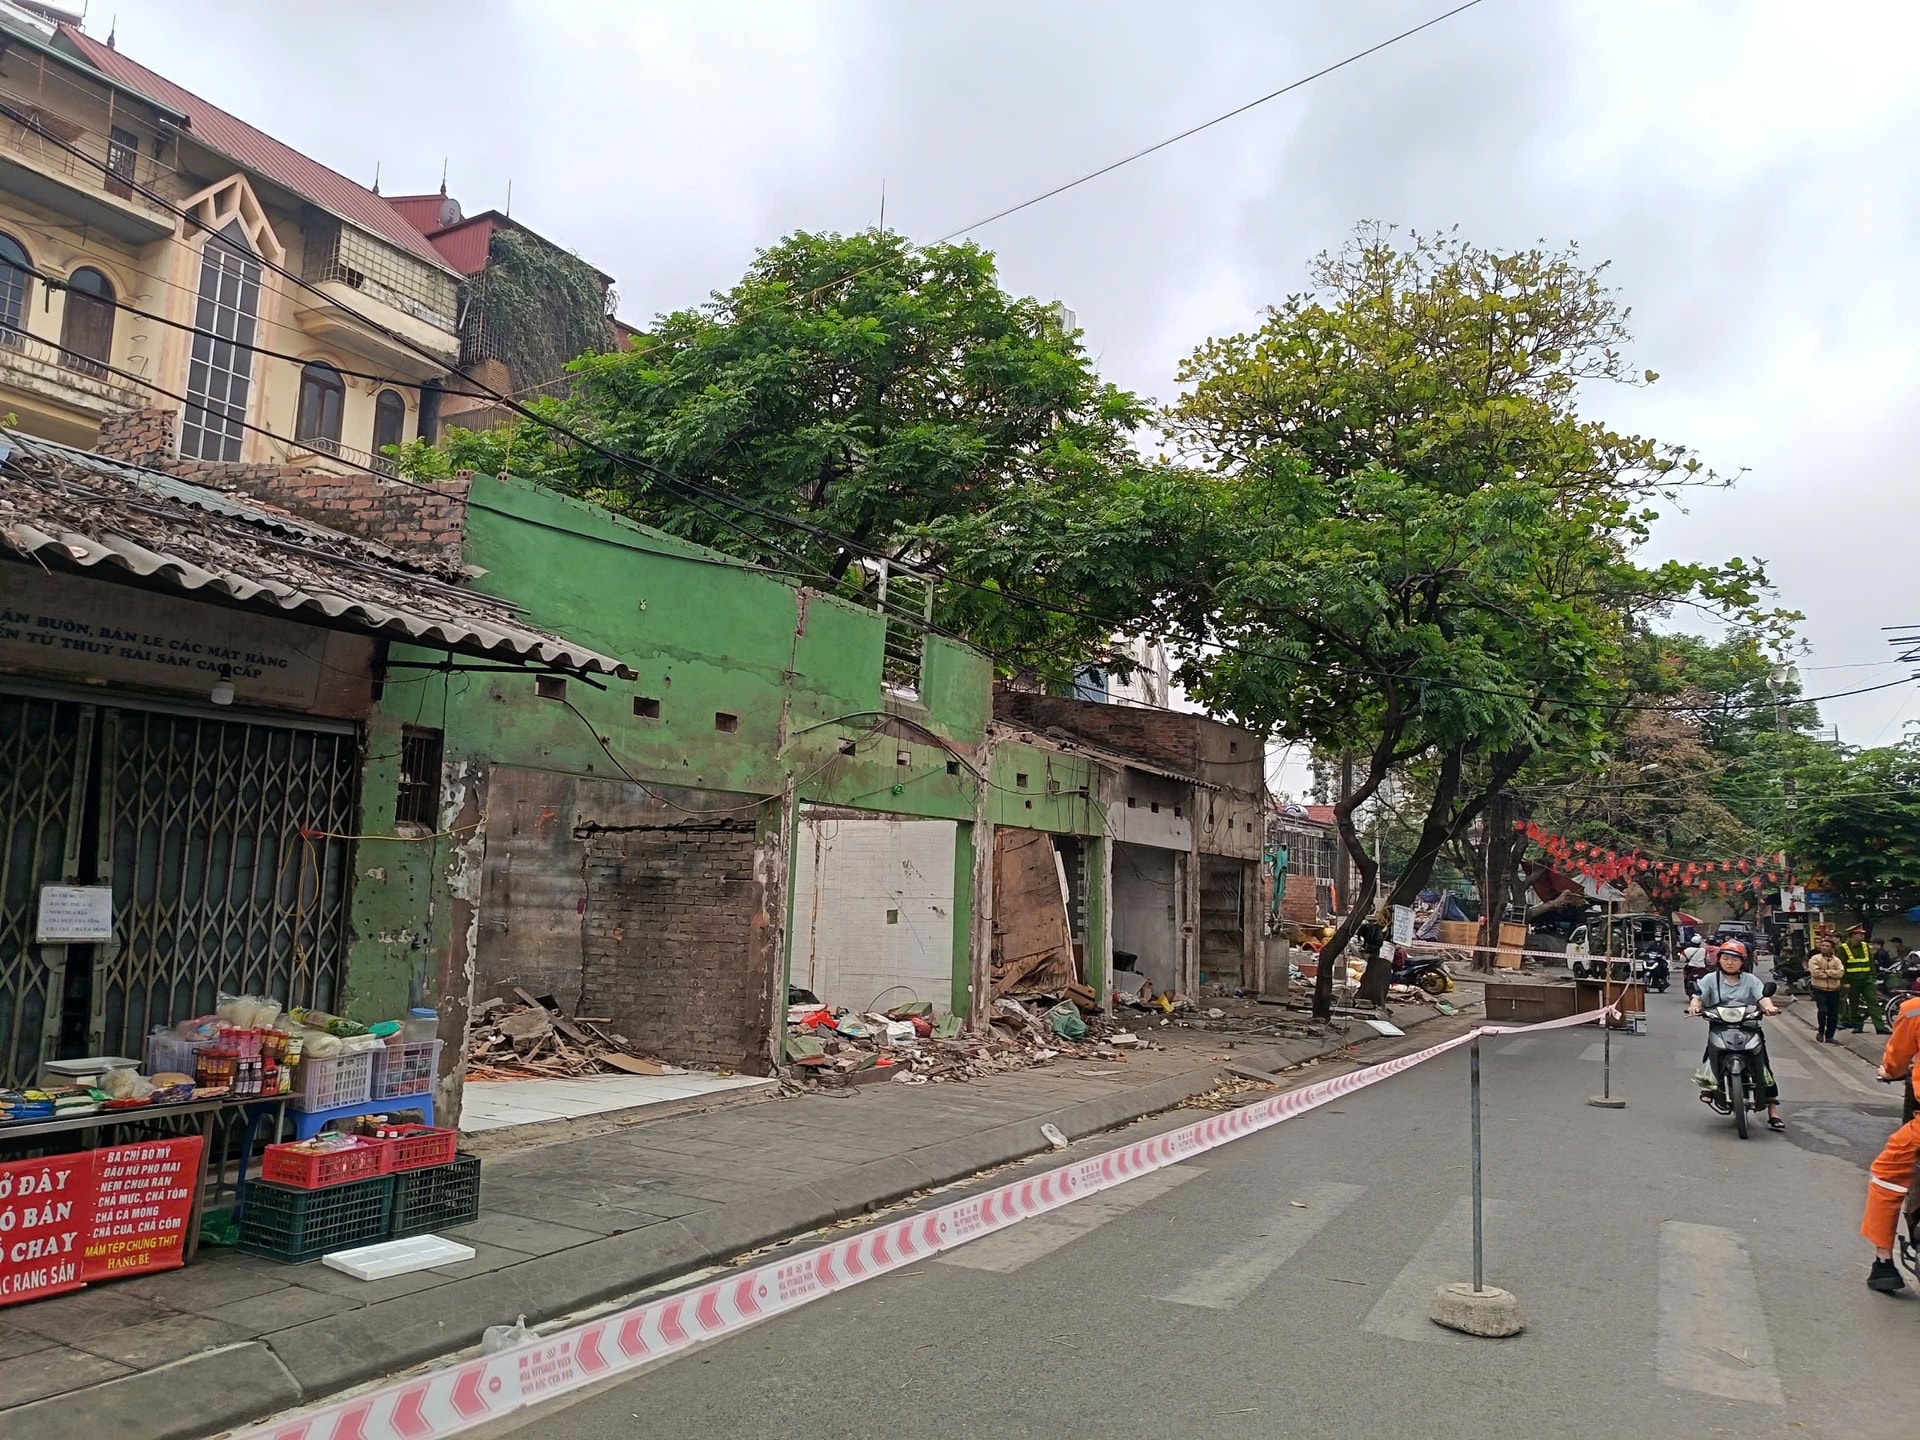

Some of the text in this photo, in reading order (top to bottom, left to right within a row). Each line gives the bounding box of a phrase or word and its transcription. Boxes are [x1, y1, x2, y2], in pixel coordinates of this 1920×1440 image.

[99, 627, 137, 642] BÁN
[168, 638, 202, 653] CÁC
[245, 651, 288, 669] HÀNG
[107, 1151, 121, 1163] BA
[123, 1146, 141, 1162] CHỈ
[161, 1162, 181, 1173] MAI
[17, 1167, 71, 1196] ĐÂY
[100, 1180, 122, 1193] NEM
[124, 1178, 149, 1190] CHUA
[98, 1192, 116, 1208] CHẢ
[145, 1187, 165, 1201] CHẢ
[167, 1187, 188, 1199] TÔM
[22, 1199, 73, 1228] BÁN
[95, 1208, 113, 1224] CHẢ
[92, 1223, 110, 1239] CHẢ
[113, 1223, 135, 1236] CUA,
[138, 1217, 156, 1233] CHẢ
[11, 1231, 78, 1263] CHAY
[14, 1267, 47, 1293] RANG
[51, 1258, 75, 1285] SẴN
